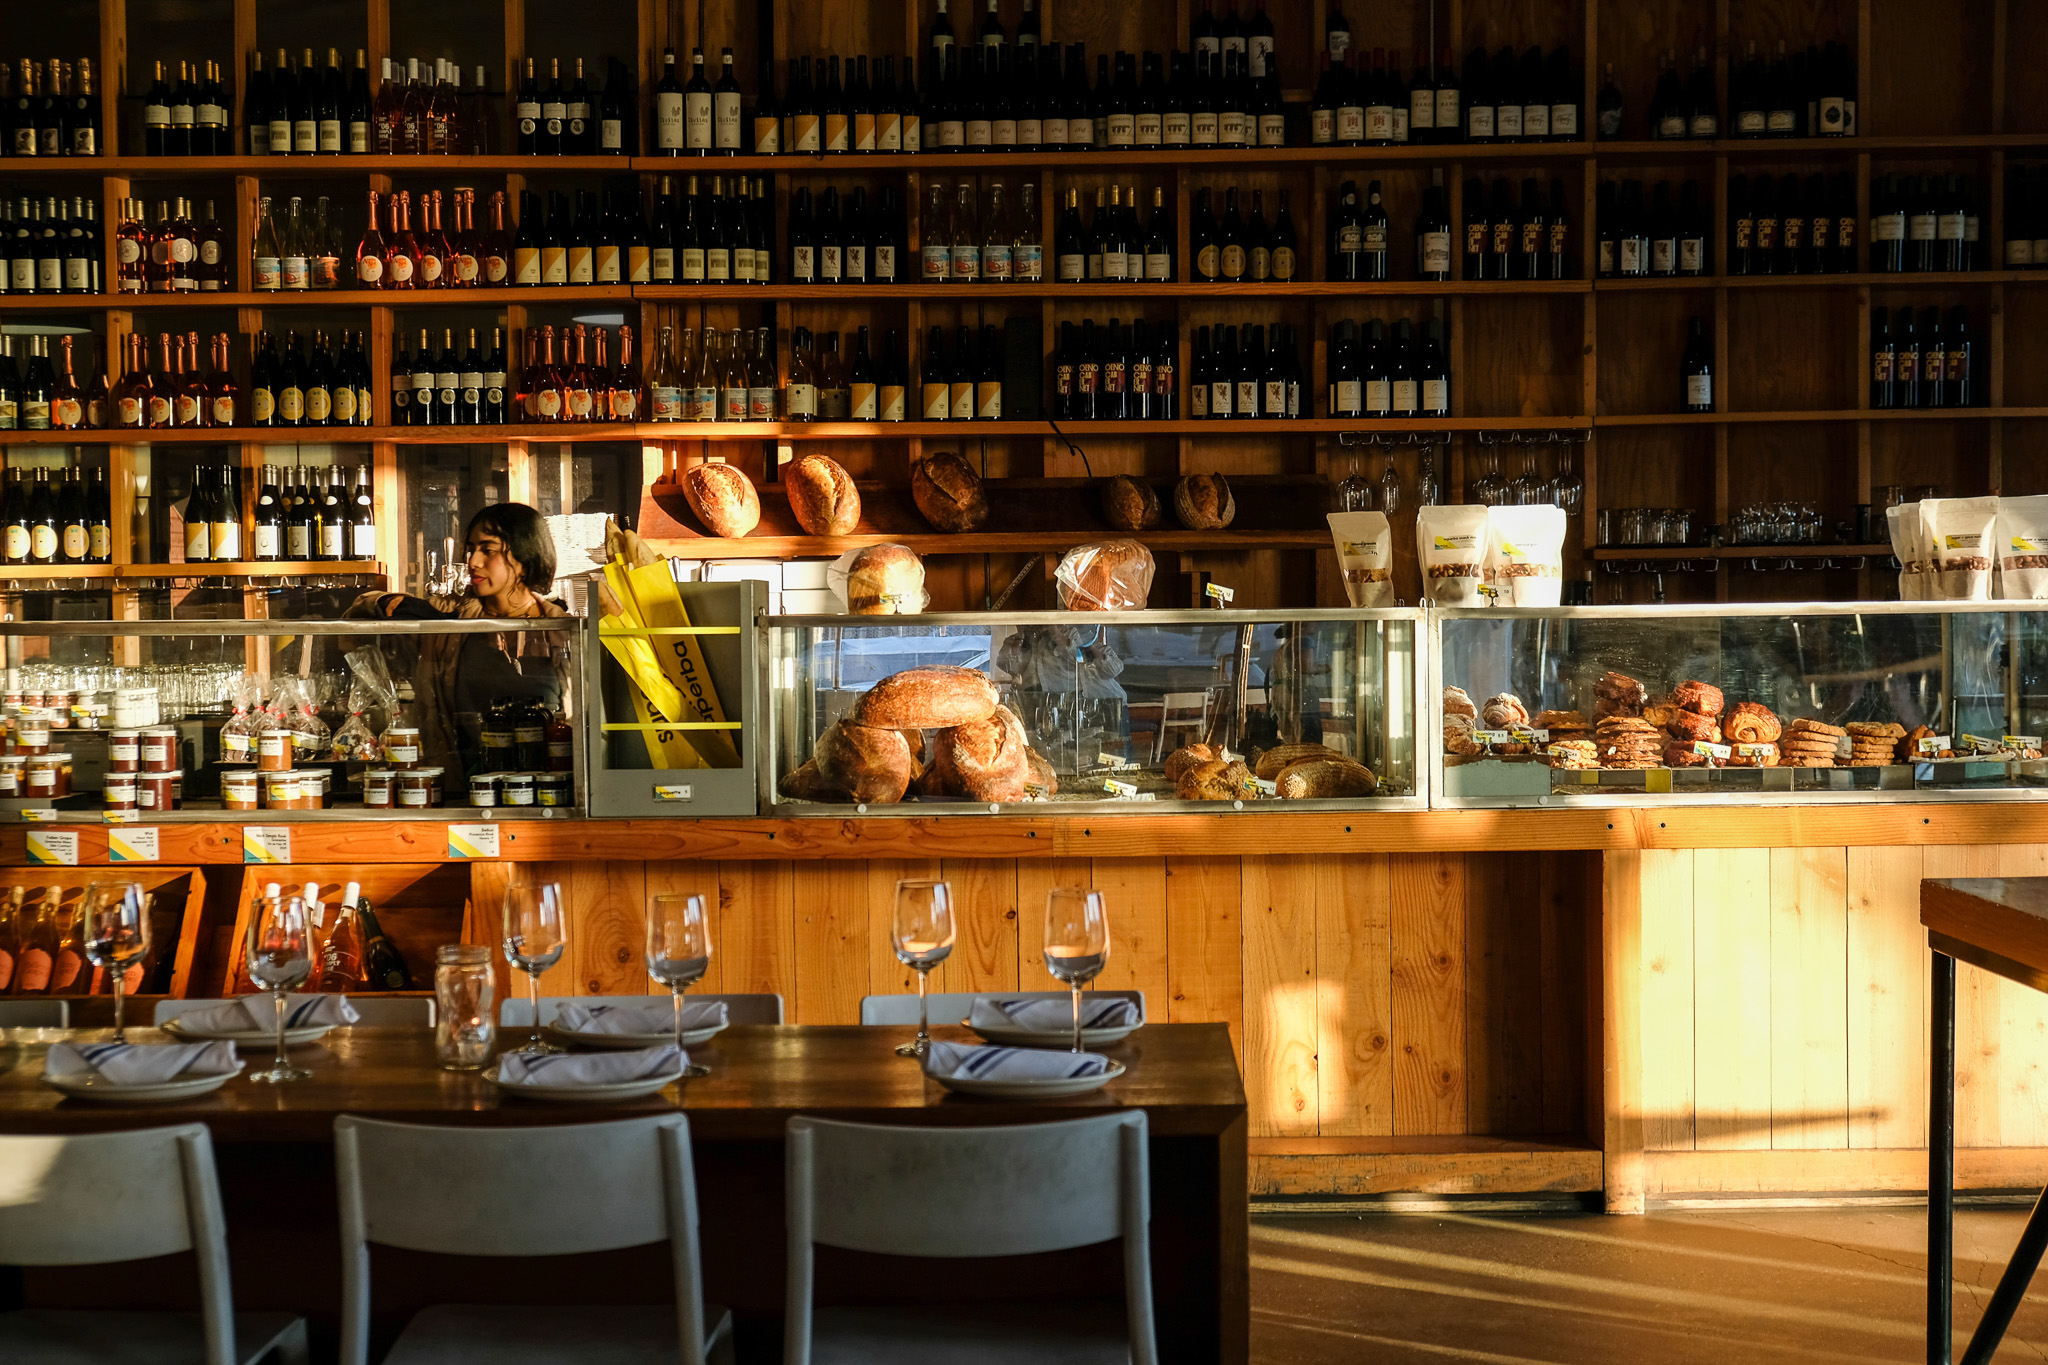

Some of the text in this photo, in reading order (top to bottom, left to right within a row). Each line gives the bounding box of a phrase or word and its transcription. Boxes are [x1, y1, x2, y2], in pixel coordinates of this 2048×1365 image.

[1738, 218, 1754, 226] OEN
[1813, 217, 1831, 226] OEN
[1840, 217, 1857, 225] OEN
[673, 640, 720, 736] uperba
